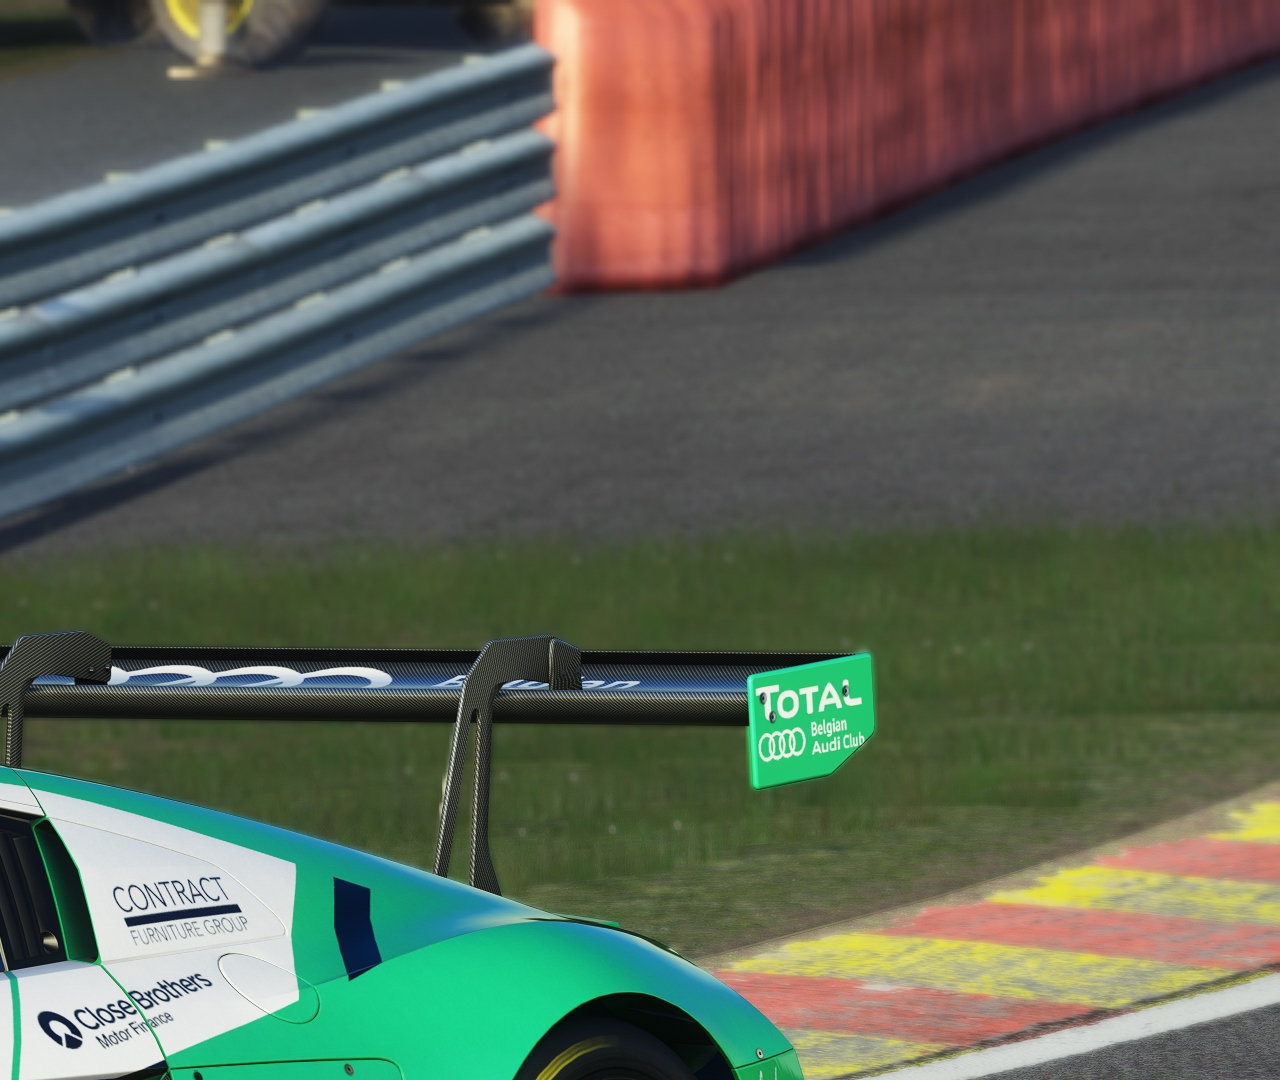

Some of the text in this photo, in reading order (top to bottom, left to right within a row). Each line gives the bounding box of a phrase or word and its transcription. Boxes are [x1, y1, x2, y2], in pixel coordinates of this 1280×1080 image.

[755, 679, 862, 721] TOTAL
[810, 718, 848, 738] Belgian
[811, 732, 865, 755] Audi Club
[112, 876, 230, 913] CONTRACT
[130, 915, 248, 946] FURNITURE GROUP
[73, 972, 213, 1031] Close Brothers
[95, 1012, 174, 1049] Motor Finance
